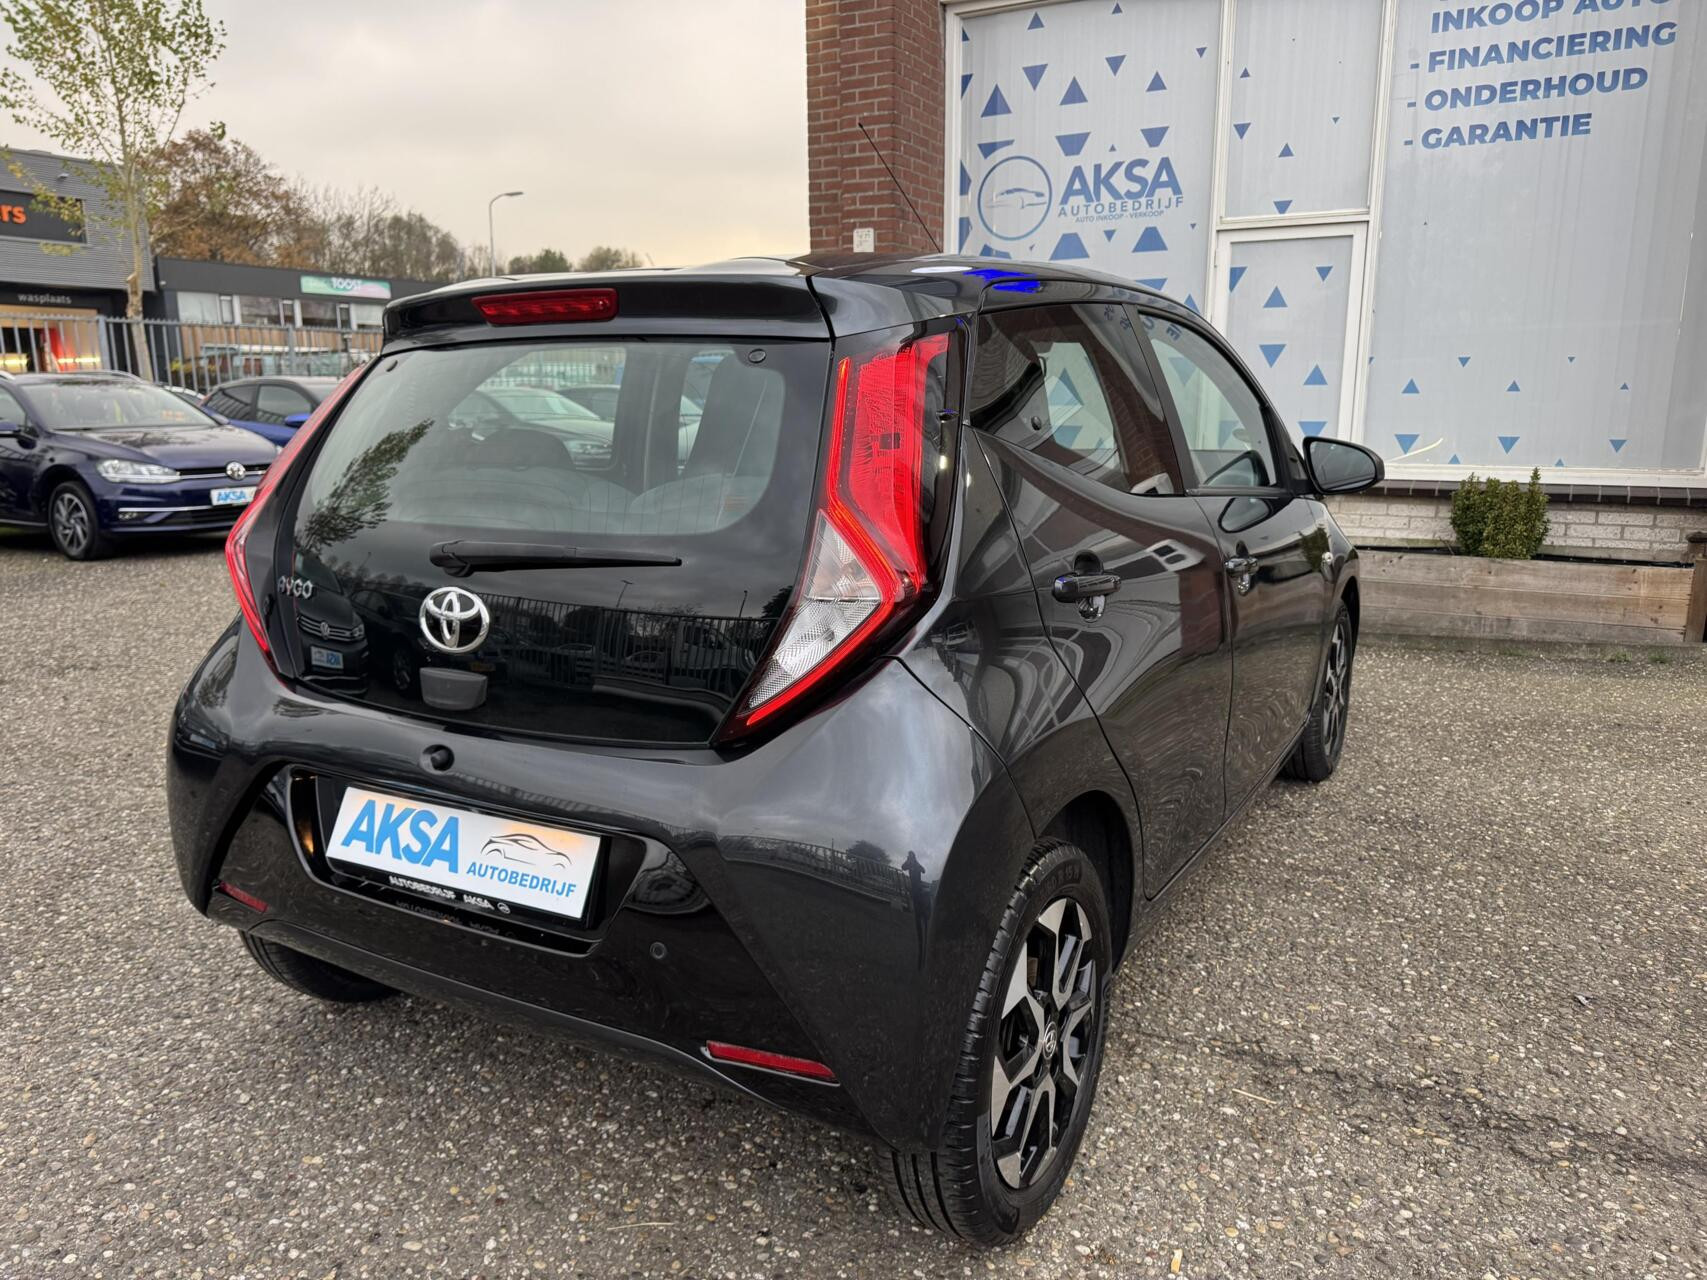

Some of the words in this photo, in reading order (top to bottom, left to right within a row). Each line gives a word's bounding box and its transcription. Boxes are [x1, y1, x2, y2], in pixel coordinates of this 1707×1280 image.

[1431, 0, 1564, 33] INKOOP
[1428, 21, 1678, 73] FINANCIERING
[1424, 67, 1649, 111] ONDERHOUD
[1421, 112, 1593, 150] GARANTIE
[1059, 156, 1183, 206] AKSA
[0, 205, 26, 224] rs
[1058, 196, 1184, 218] AUTOBEDRIJF
[1075, 214, 1095, 223] AUTO
[1129, 210, 1165, 220] VERKOOP
[17, 292, 72, 305] wasplaats
[277, 575, 313, 599] AYGO
[341, 799, 459, 874] AKSA
[466, 861, 577, 898] AUTOBEDRIJF
